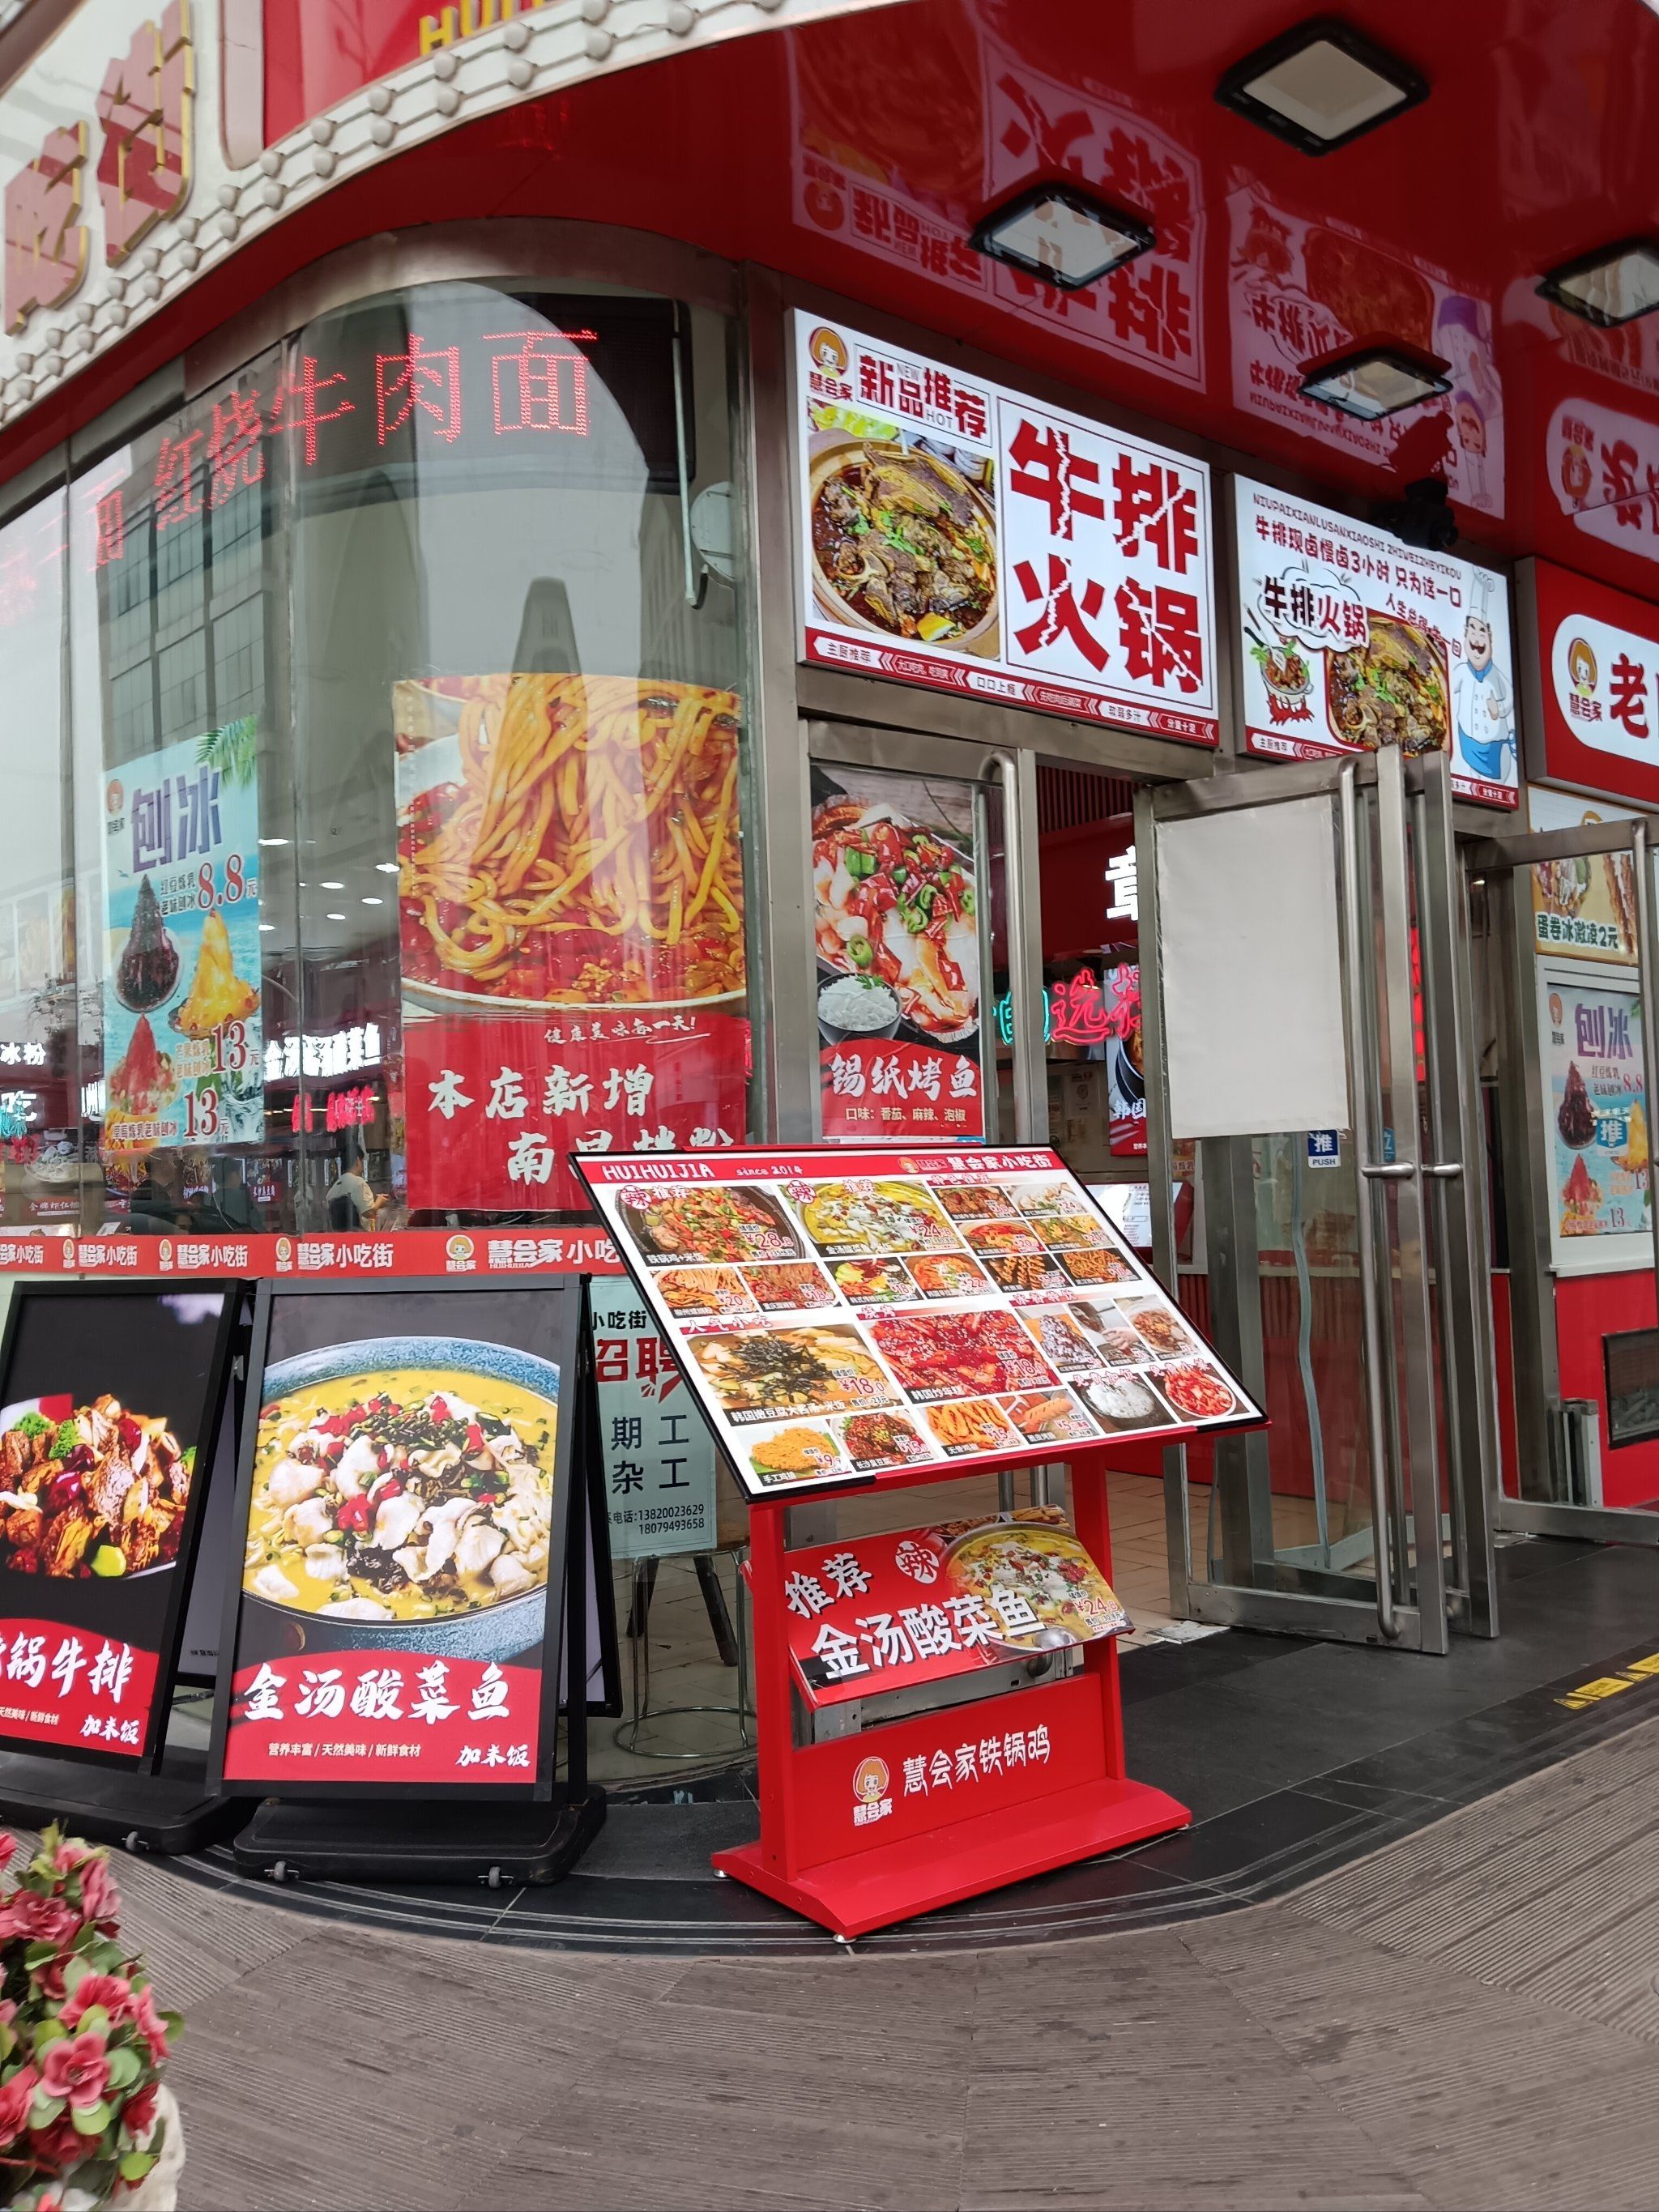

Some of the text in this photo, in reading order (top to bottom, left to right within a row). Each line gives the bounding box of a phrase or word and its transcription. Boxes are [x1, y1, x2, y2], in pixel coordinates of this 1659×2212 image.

[859, 354, 987, 439] 新品推荐
[897, 363, 920, 381] NEW
[926, 410, 953, 428] HOT
[1009, 419, 1200, 574] 牛排
[1256, 514, 1462, 609] 牛排现卤慢卤3小时 只为这一口
[1013, 553, 1203, 694] 火锅
[1264, 574, 1369, 647] 牛排火锅
[1609, 652, 1659, 740] 老
[131, 765, 222, 874] 刨冰
[1575, 1004, 1633, 1060] 刨冰
[427, 1063, 655, 1121] 本店新增
[1623, 1072, 1643, 1093] 8.8
[767, 1166, 806, 1175] 2014
[942, 1153, 1056, 1171] 慧会家小吃街
[1311, 1158, 1336, 1166] PUSH
[1314, 1132, 1334, 1153] 推
[648, 1184, 693, 1200] 推荐
[680, 1313, 774, 1335] 人气小吃
[638, 1517, 705, 1536] 18079493658
[784, 1541, 940, 1618] 推荐 辣
[812, 1590, 1049, 1679] 金汤酸菜鱼
[0, 1630, 134, 1704] 锅牛排
[242, 1659, 511, 1725] 金汤酸菜鱼
[79, 1714, 140, 1745] 加米饭
[455, 1743, 531, 1769] 加米饭
[902, 1724, 1051, 1797] 慧会家铁锅鸡
